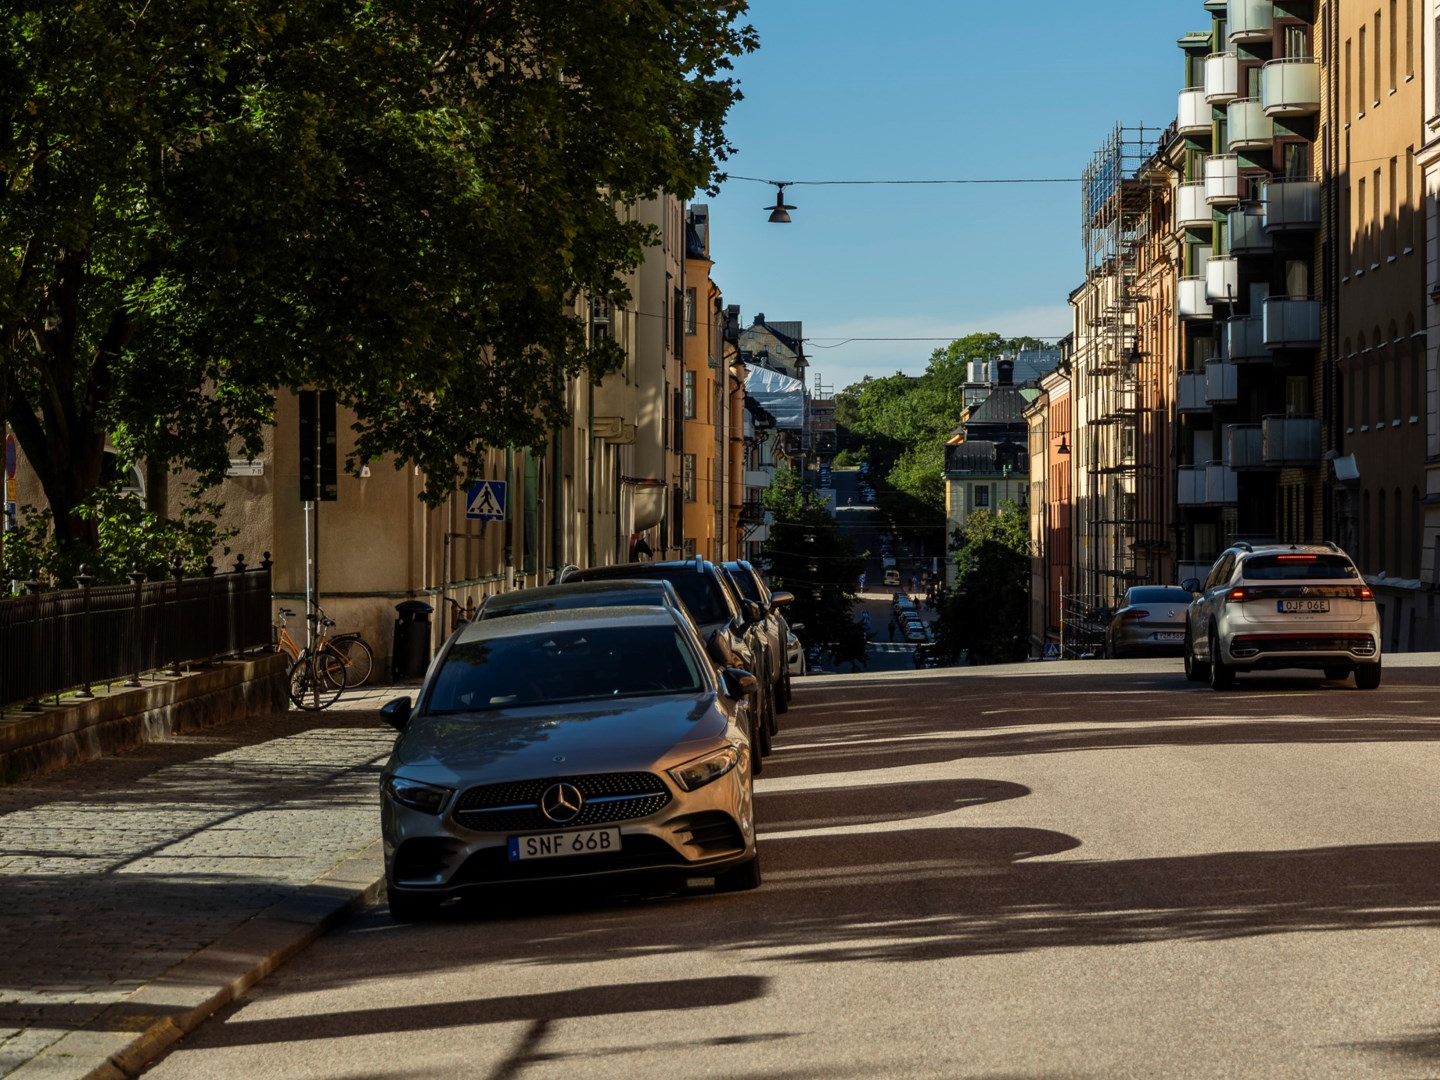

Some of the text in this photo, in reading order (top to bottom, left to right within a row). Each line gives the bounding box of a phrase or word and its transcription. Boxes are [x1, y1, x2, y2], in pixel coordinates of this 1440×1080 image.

[1307, 601, 1325, 610] 06E
[526, 831, 611, 856] SNF 66B
